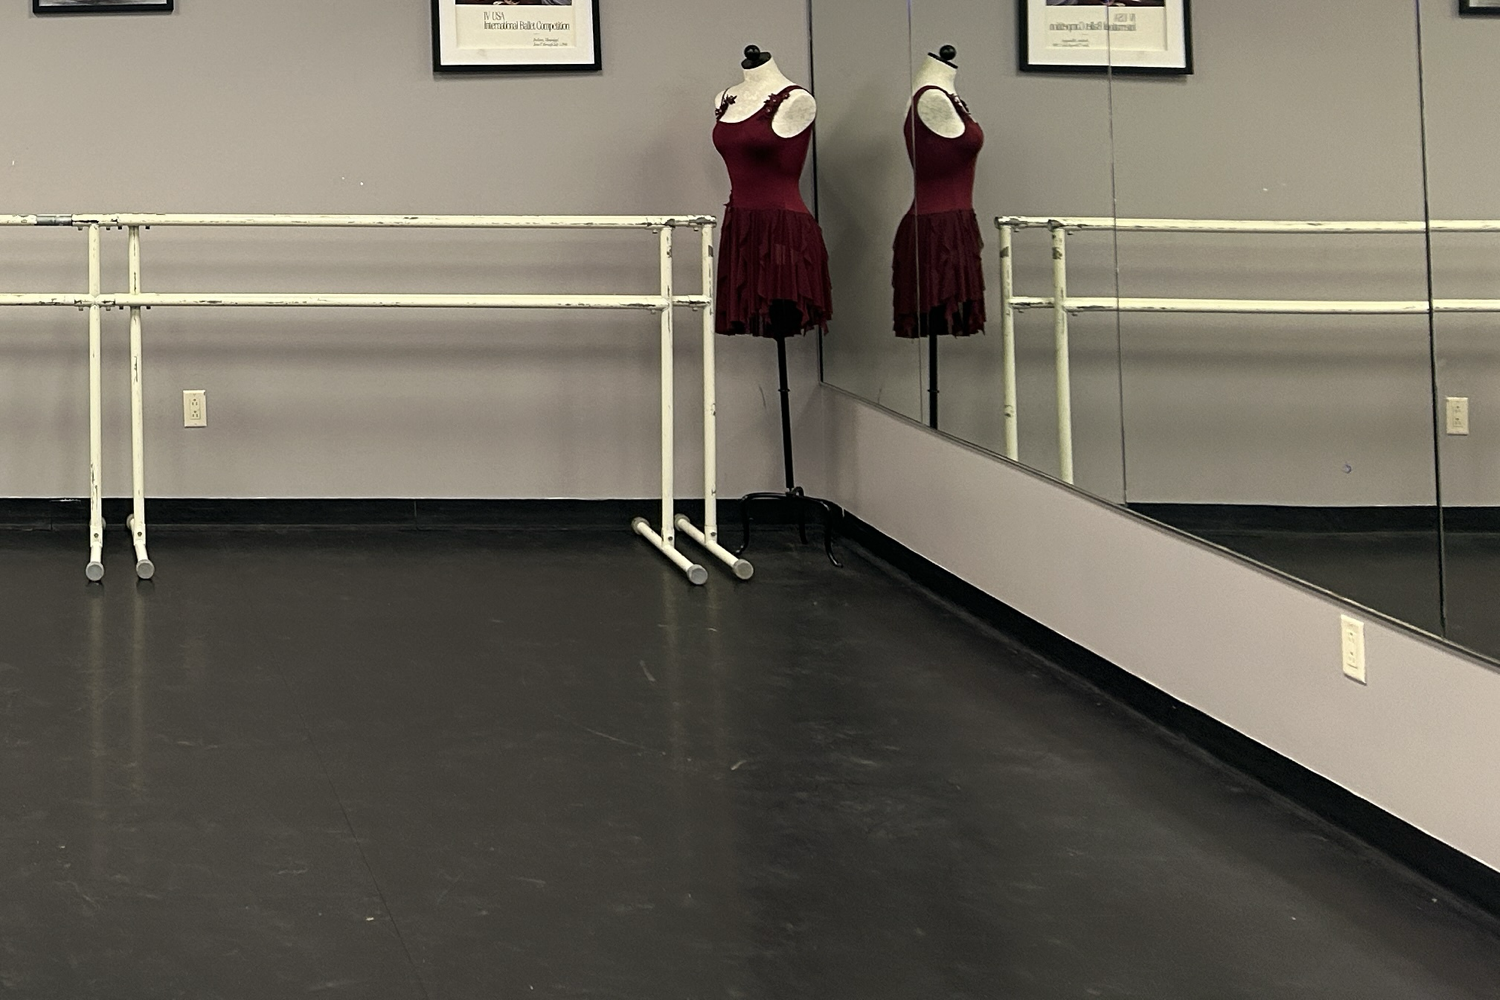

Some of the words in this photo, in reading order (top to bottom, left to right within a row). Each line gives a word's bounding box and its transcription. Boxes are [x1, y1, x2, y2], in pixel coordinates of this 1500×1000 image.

[492, 11, 506, 21] USA
[484, 21, 519, 30] International
[520, 21, 536, 31] Ballet
[537, 21, 570, 32] Competition
